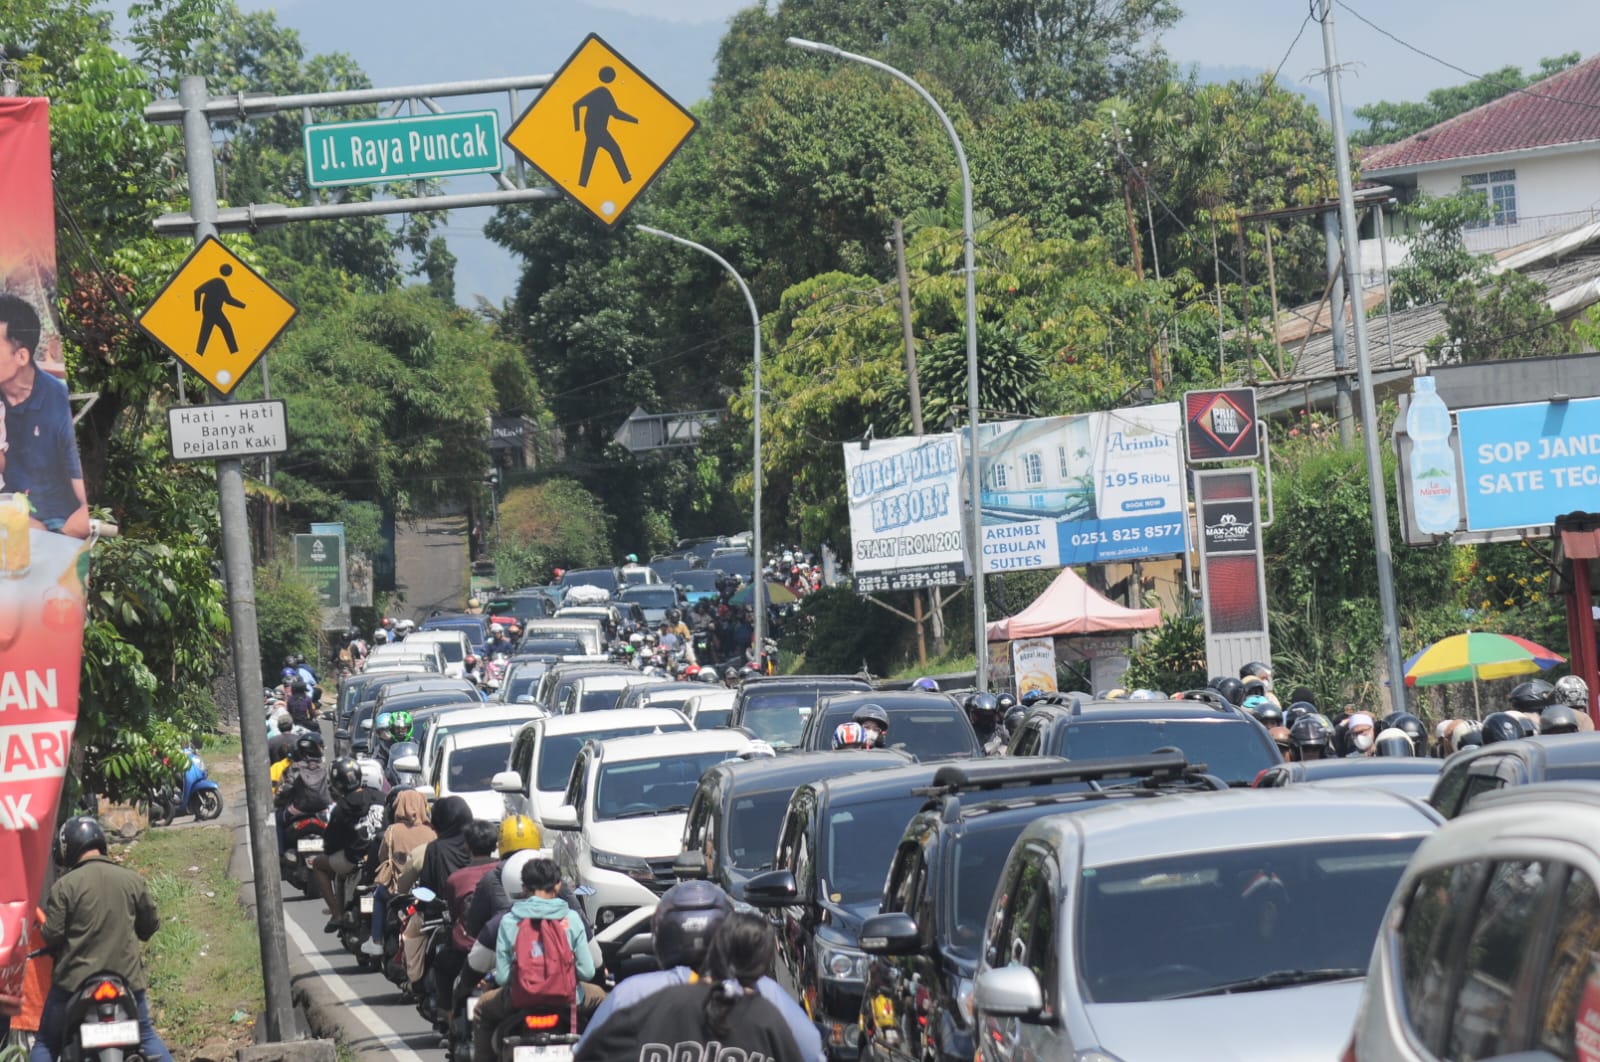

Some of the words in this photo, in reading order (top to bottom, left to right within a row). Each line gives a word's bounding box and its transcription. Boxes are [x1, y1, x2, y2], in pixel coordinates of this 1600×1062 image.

[321, 136, 346, 170] Jl.
[351, 136, 404, 174] Raya
[409, 123, 489, 163] Puncak
[181, 410, 215, 424] Hati
[240, 406, 273, 420] Hati
[202, 422, 255, 437] Banyak
[183, 439, 239, 454] Pejalan
[245, 435, 277, 449] Kaki
[1107, 431, 1169, 452] Arimbi
[1478, 441, 1530, 464] SOP
[1105, 472, 1138, 487] 195
[1141, 474, 1170, 484] Ribu
[1479, 470, 1544, 494] SATE
[1550, 464, 1600, 488] TEG
[871, 483, 949, 532] RESORT
[986, 524, 1041, 539] ARIMBI
[1071, 533, 1108, 546] 0251
[1112, 528, 1140, 540] 825
[1144, 524, 1181, 538] 8577
[857, 538, 897, 560] START
[898, 533, 936, 556] FROM
[983, 539, 1046, 554] CIBULAN
[990, 555, 1042, 569] SUITES
